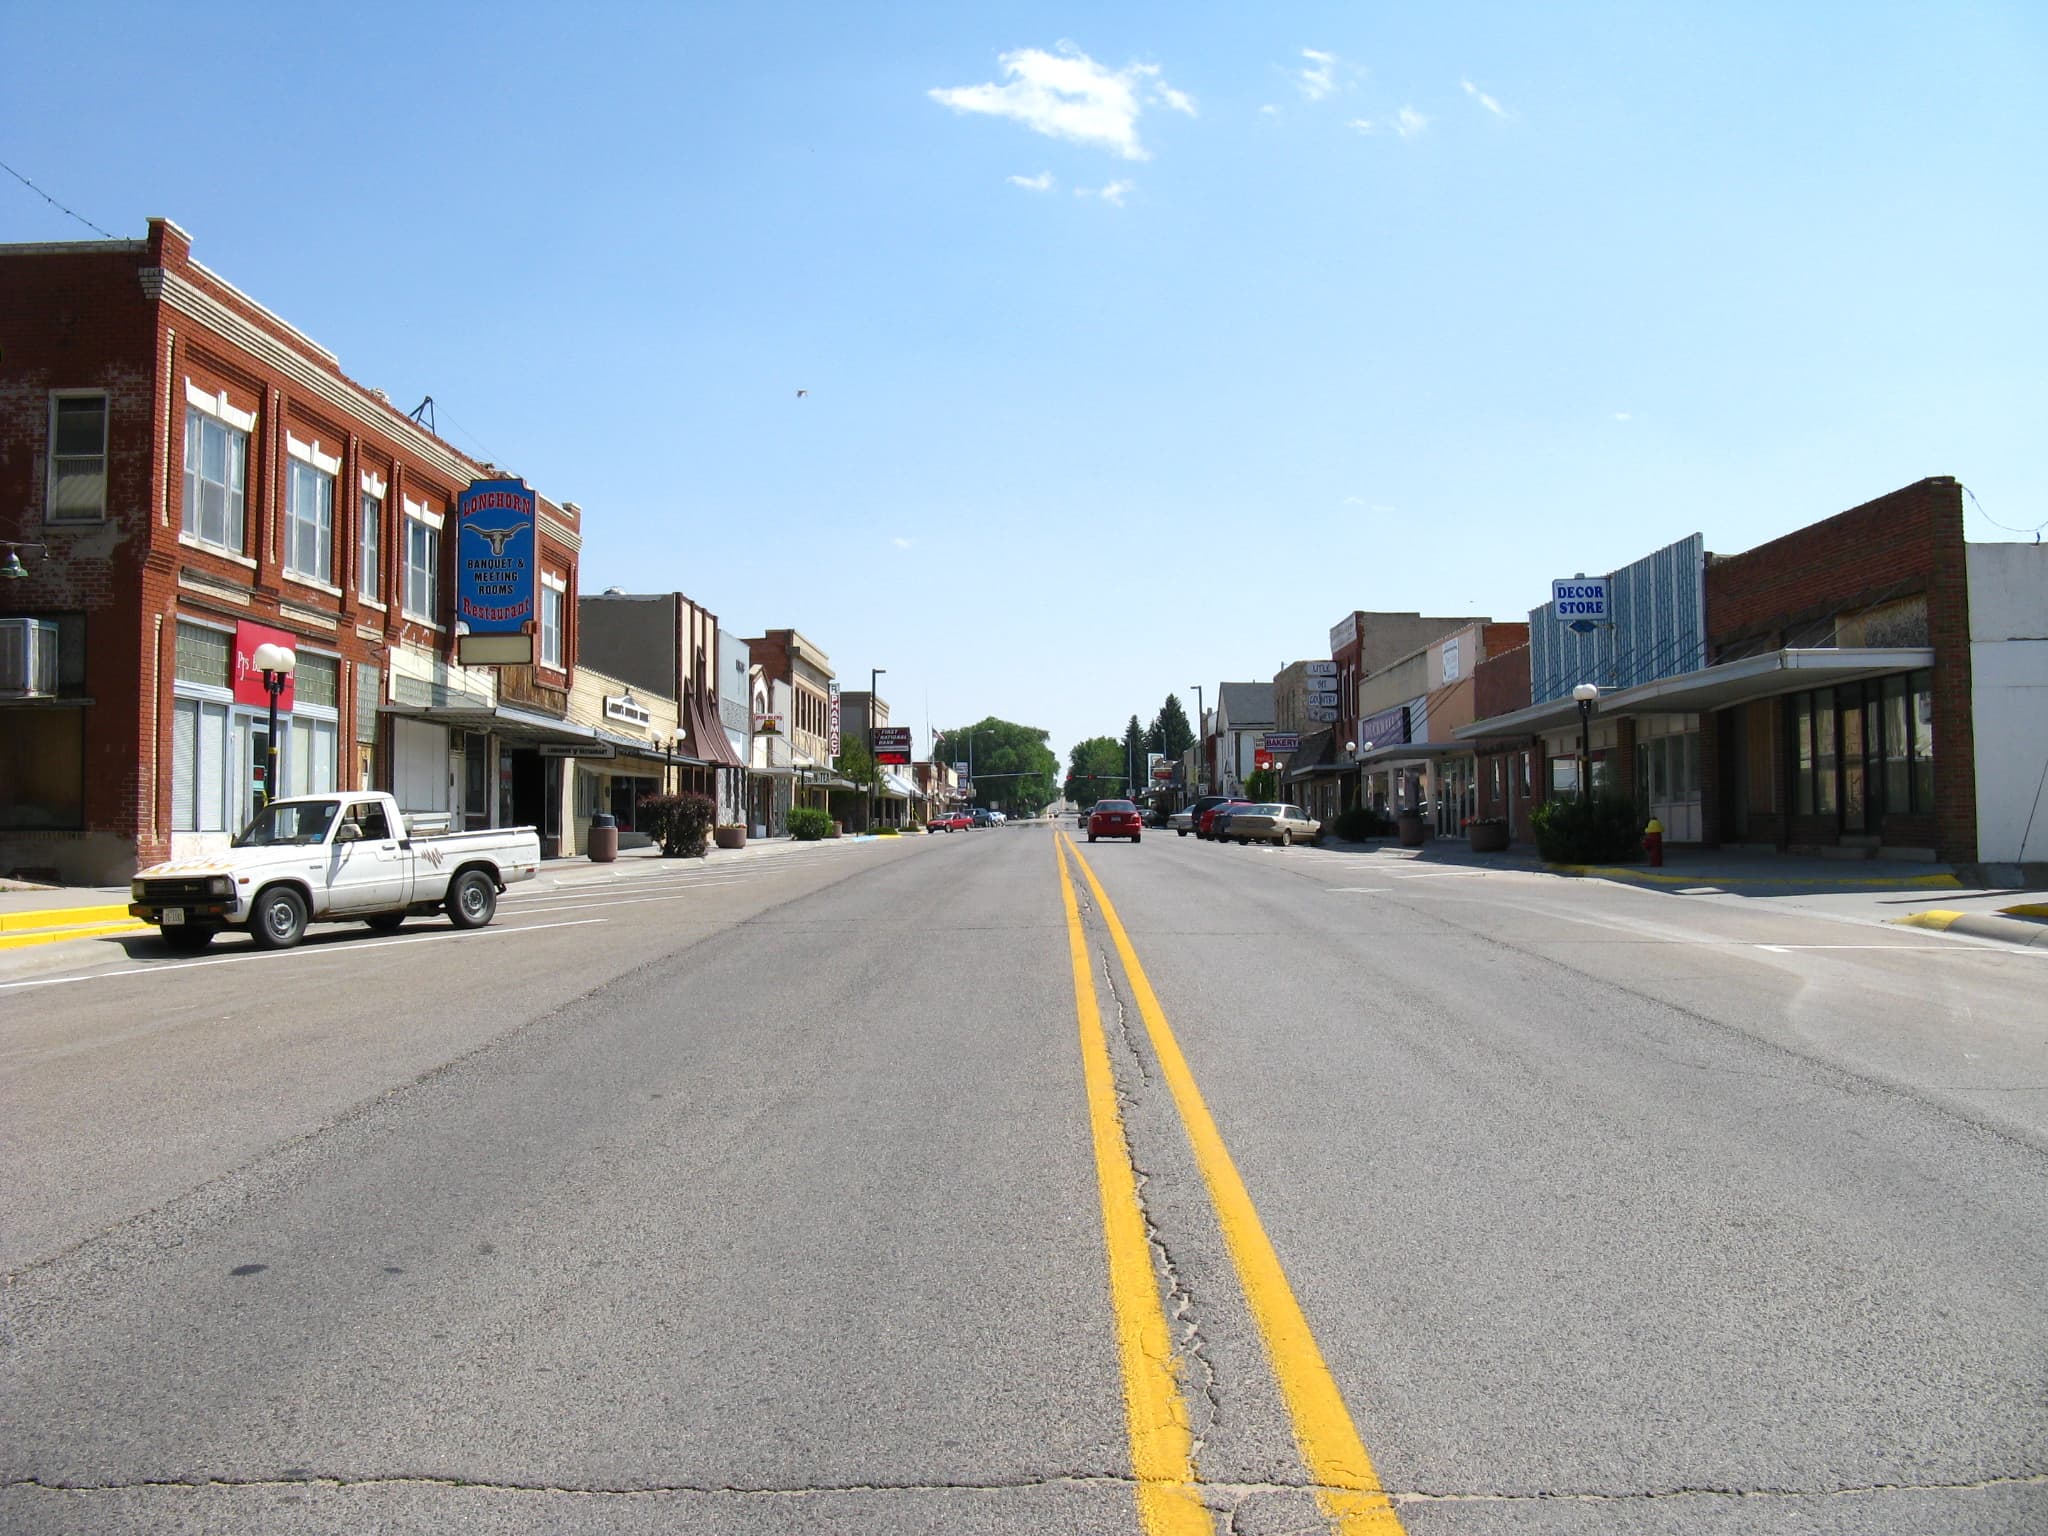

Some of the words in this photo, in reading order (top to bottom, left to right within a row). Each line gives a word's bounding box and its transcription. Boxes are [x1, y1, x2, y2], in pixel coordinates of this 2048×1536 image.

[463, 491, 531, 517] LONGHORN
[467, 559, 512, 570] BANQUET
[517, 559, 524, 569] &
[474, 572, 518, 582] MEETING
[478, 585, 513, 595] ROOMS
[1557, 586, 1604, 599] DECOR
[463, 597, 530, 621] Restaurant
[1559, 601, 1604, 614] STORE
[831, 694, 839, 756] PHARMACY
[1266, 738, 1298, 748] BAKERY
